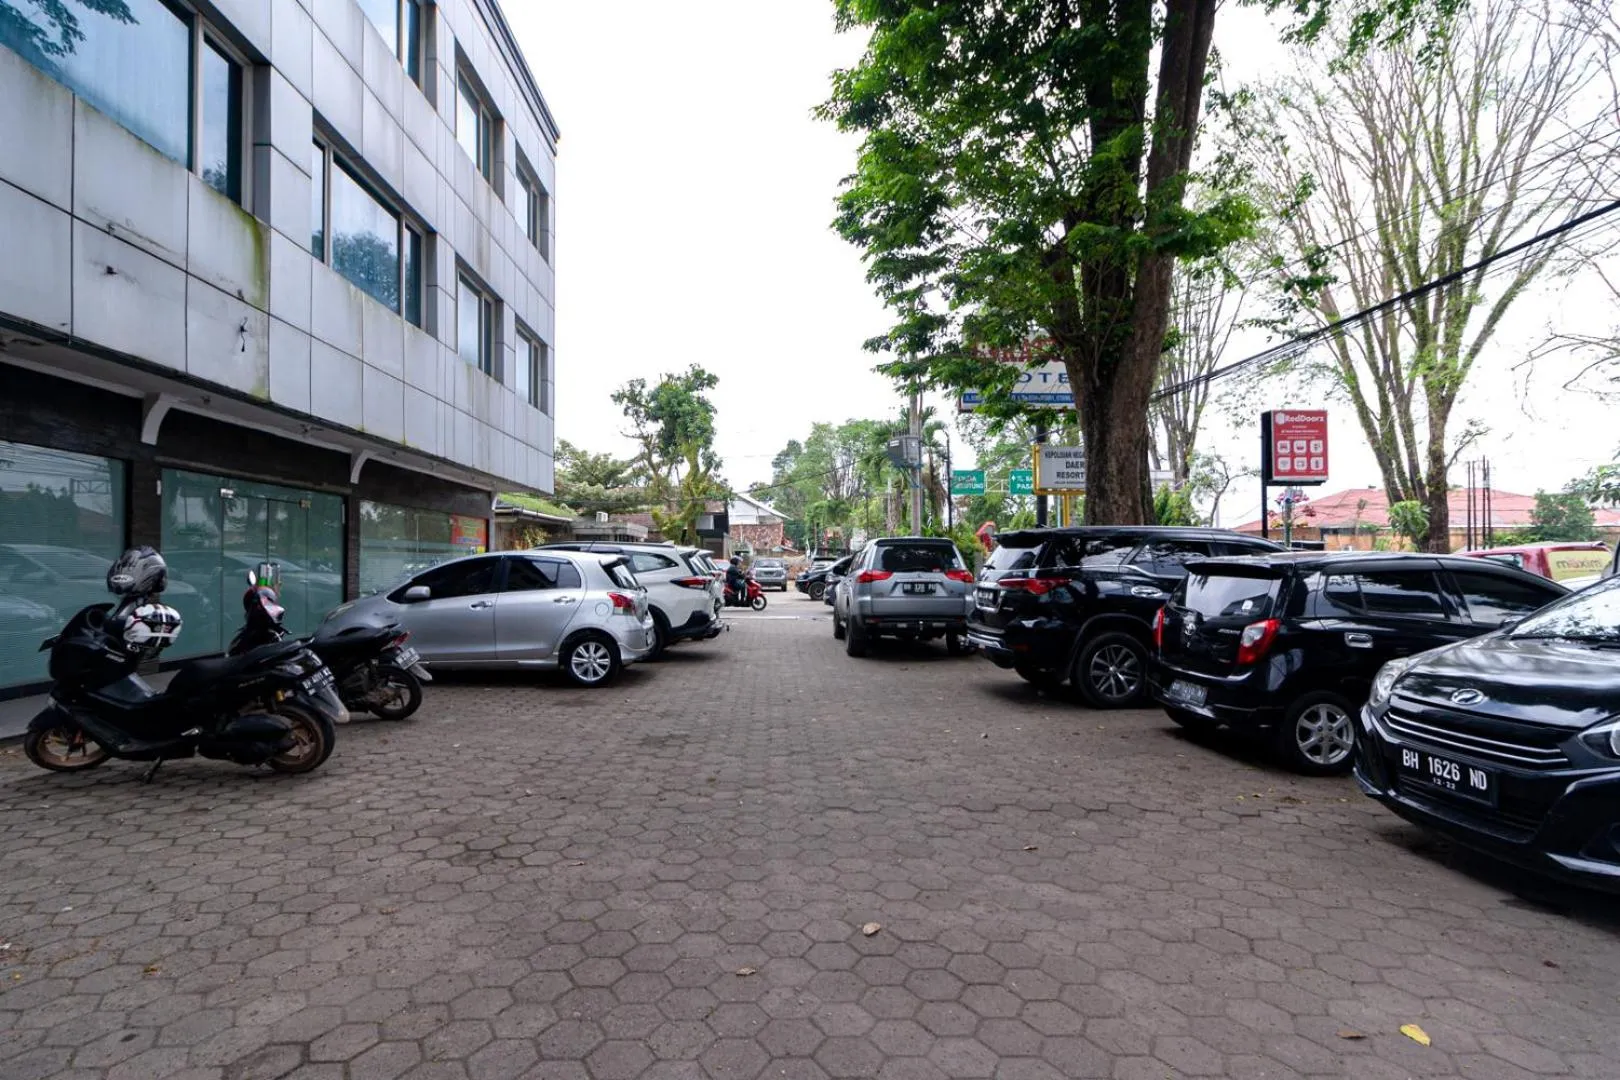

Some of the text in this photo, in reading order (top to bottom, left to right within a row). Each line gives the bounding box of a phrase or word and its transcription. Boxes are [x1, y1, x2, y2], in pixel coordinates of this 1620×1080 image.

[1017, 372, 1069, 383] OTE
[1402, 748, 1488, 791] BH 1626 ND
